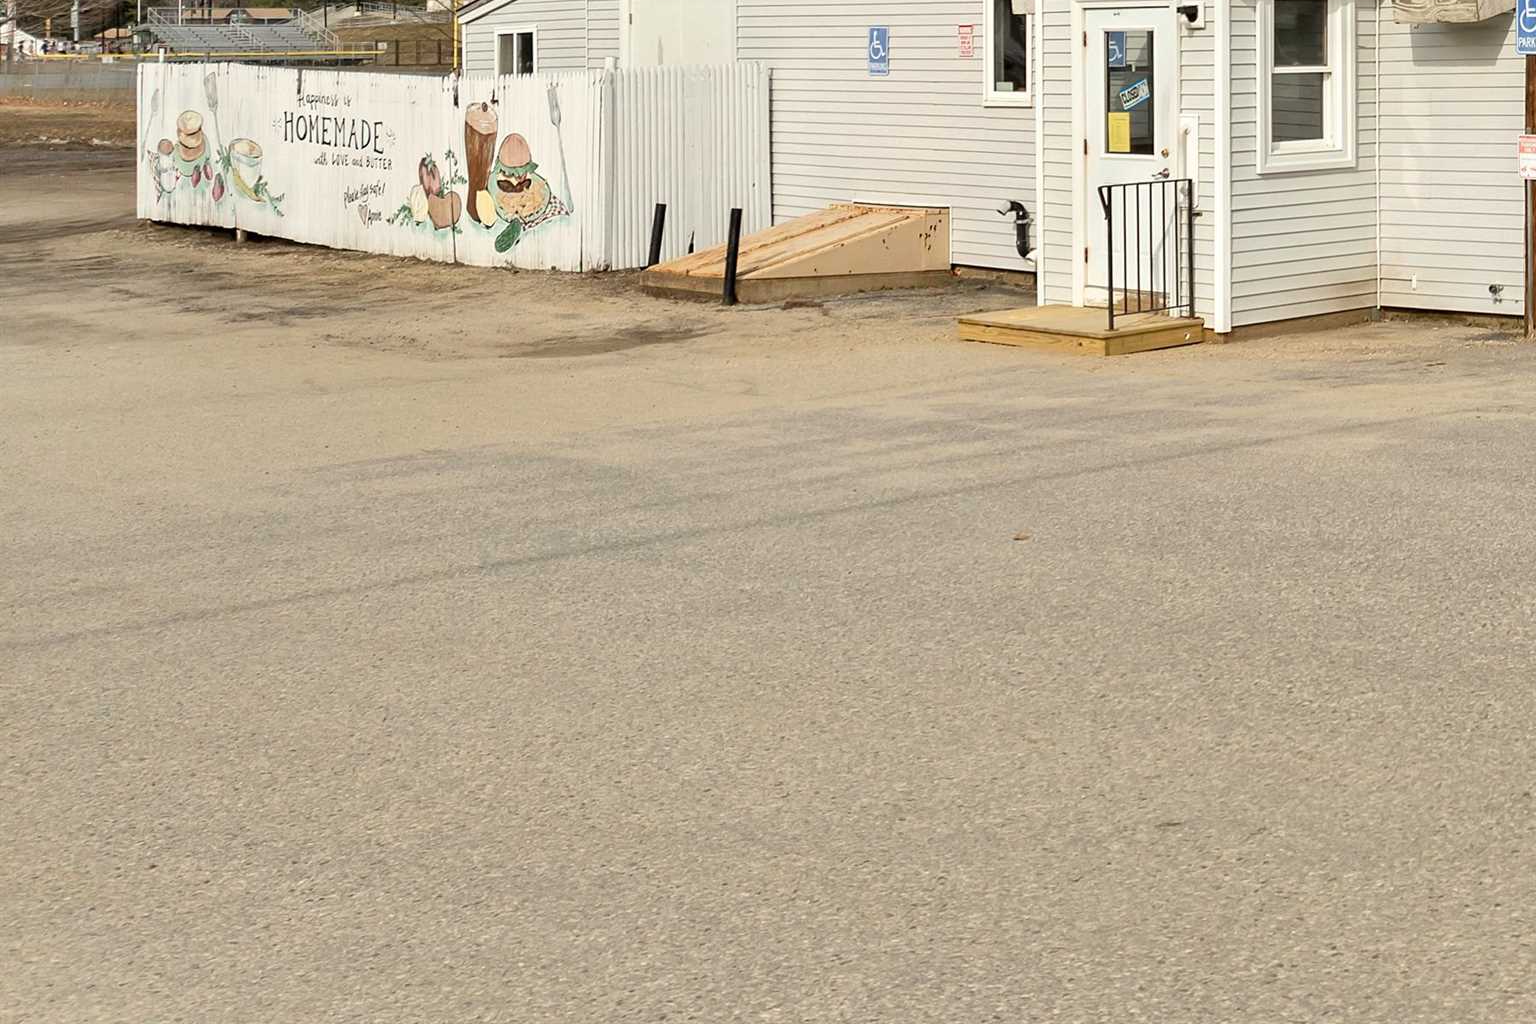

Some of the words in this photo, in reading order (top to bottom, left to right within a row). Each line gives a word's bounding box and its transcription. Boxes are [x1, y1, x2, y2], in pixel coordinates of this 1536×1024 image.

[297, 93, 339, 110] Happiness
[284, 111, 384, 154] HOMEMADE
[331, 152, 349, 166] LOVE
[351, 157, 363, 168] and
[366, 156, 392, 171] BUTTER
